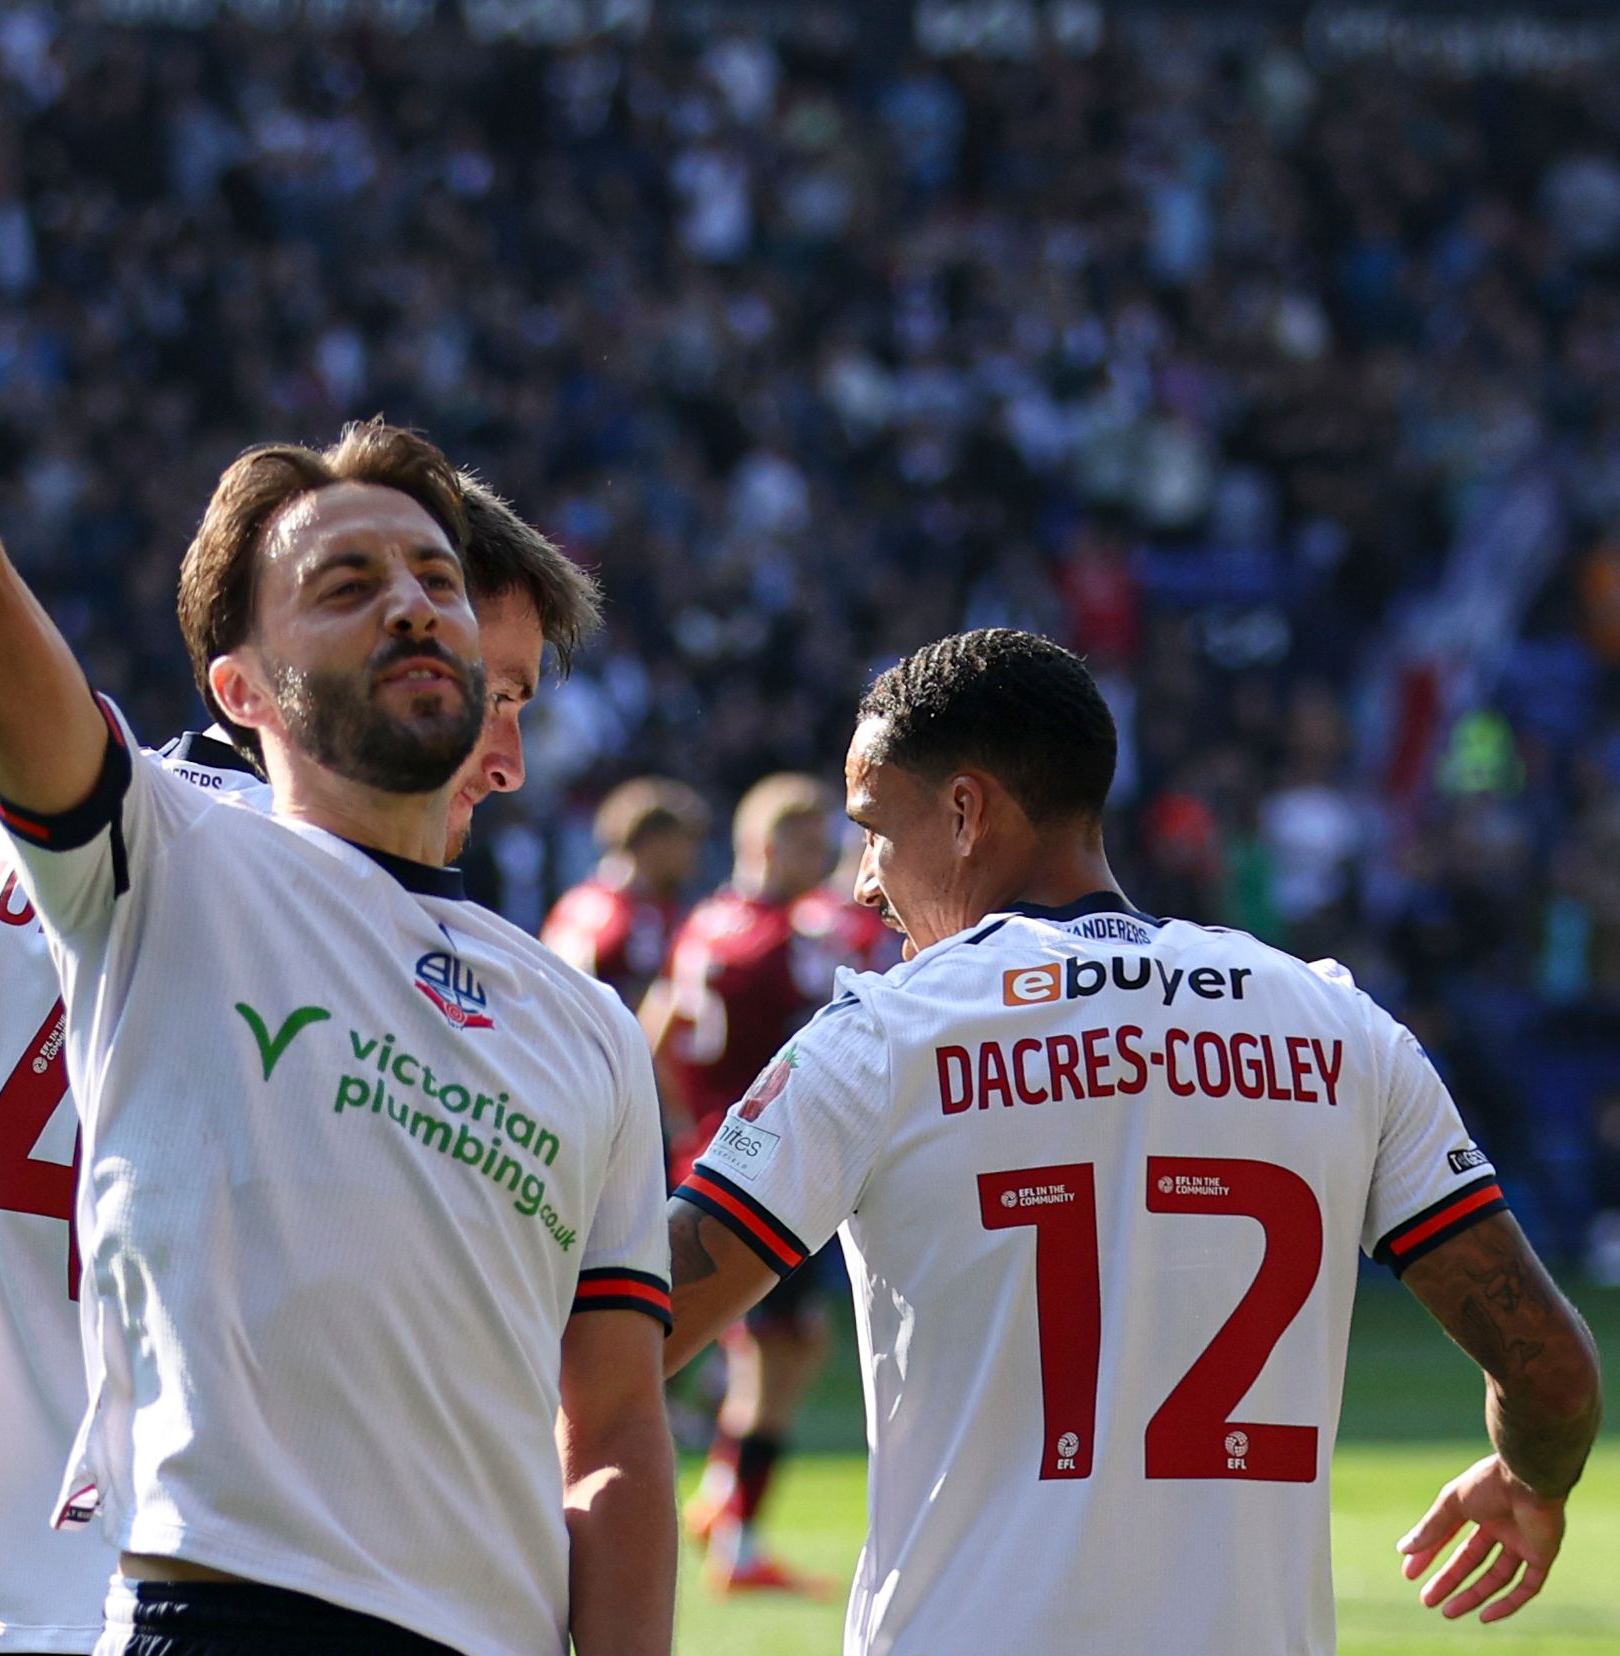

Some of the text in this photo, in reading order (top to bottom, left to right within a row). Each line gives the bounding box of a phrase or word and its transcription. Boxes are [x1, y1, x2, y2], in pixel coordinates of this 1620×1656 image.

[1003, 957, 1252, 1006] ebuyer
[935, 1025, 1342, 1115] DACRES-COGLEY
[349, 1029, 560, 1167] victorian
[333, 1074, 546, 1217] plumbing
[1175, 1176, 1220, 1187] EFL IN THE
[1019, 1184, 1065, 1198] EFL IN THE
[1175, 1186, 1230, 1196] COMMUNITY
[1019, 1193, 1075, 1207] COMMUNITY
[977, 1156, 1323, 1483] 12
[1057, 1458, 1076, 1470] EFL
[1227, 1458, 1247, 1470] EFL
